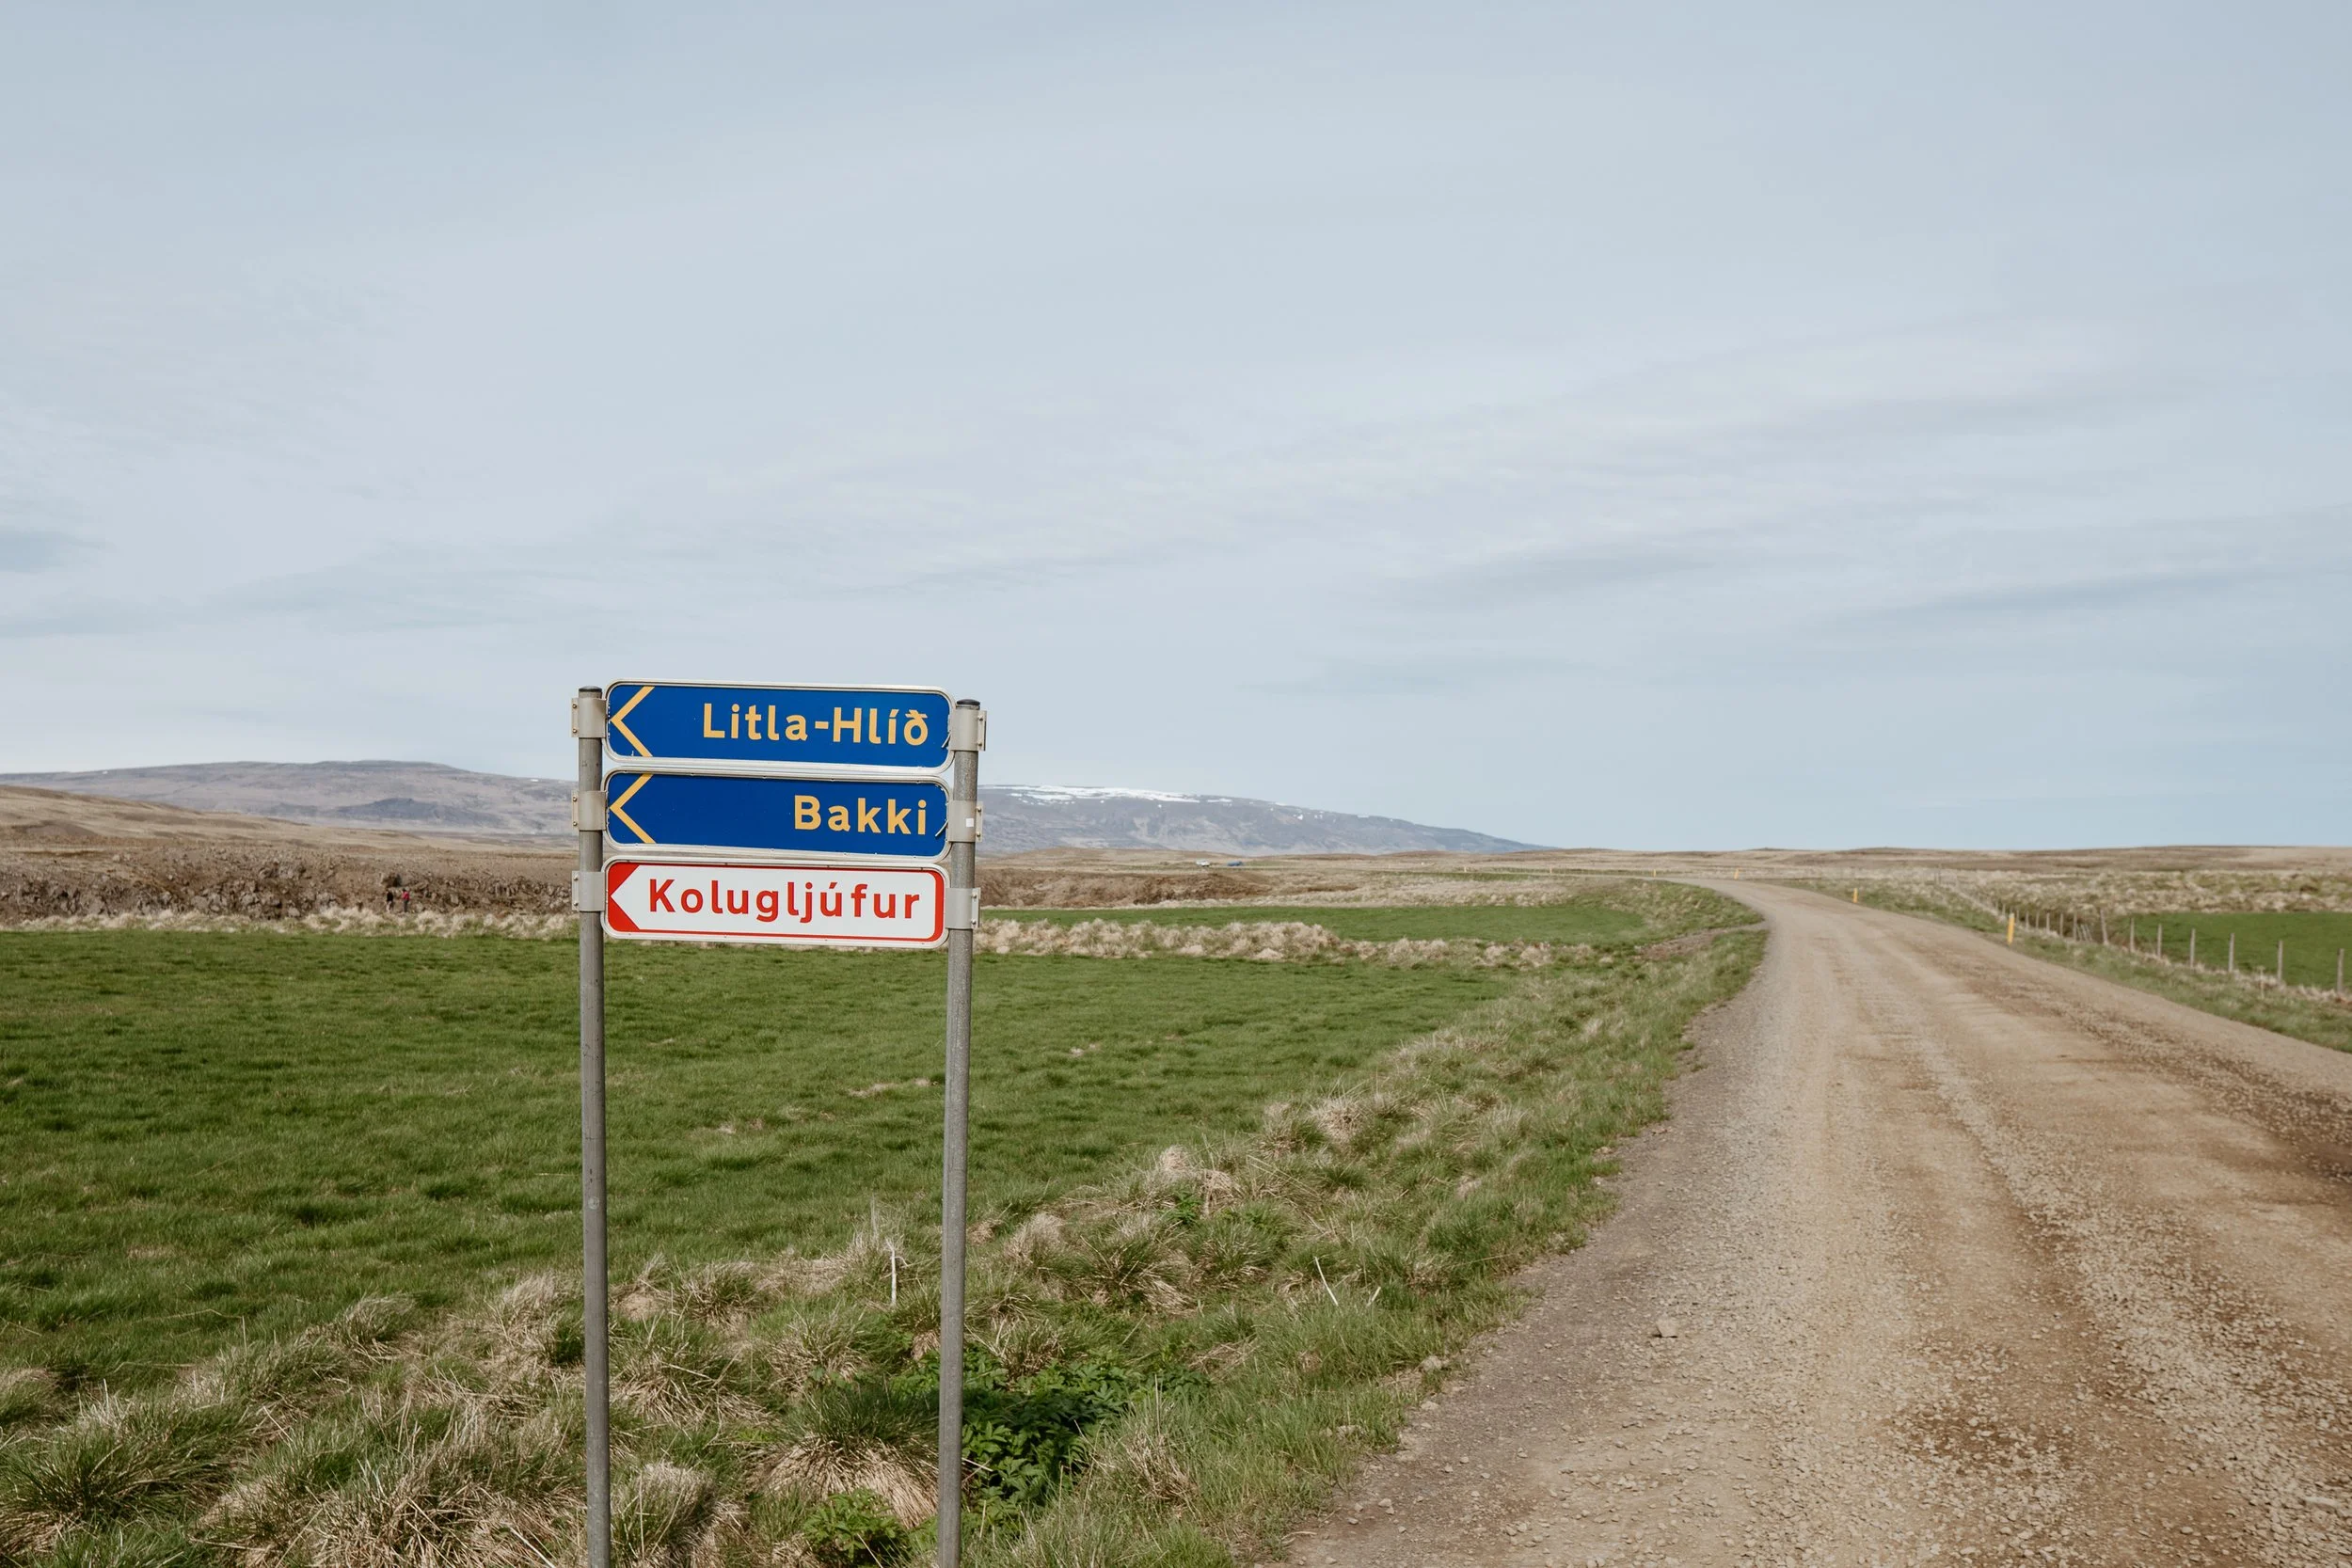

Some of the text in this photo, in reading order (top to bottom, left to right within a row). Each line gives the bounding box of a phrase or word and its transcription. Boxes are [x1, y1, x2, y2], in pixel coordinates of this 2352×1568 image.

[703, 703, 929, 746] Litla-Hlíð
[794, 795, 928, 835] Bakki
[649, 878, 920, 924] Kolugljúfur
